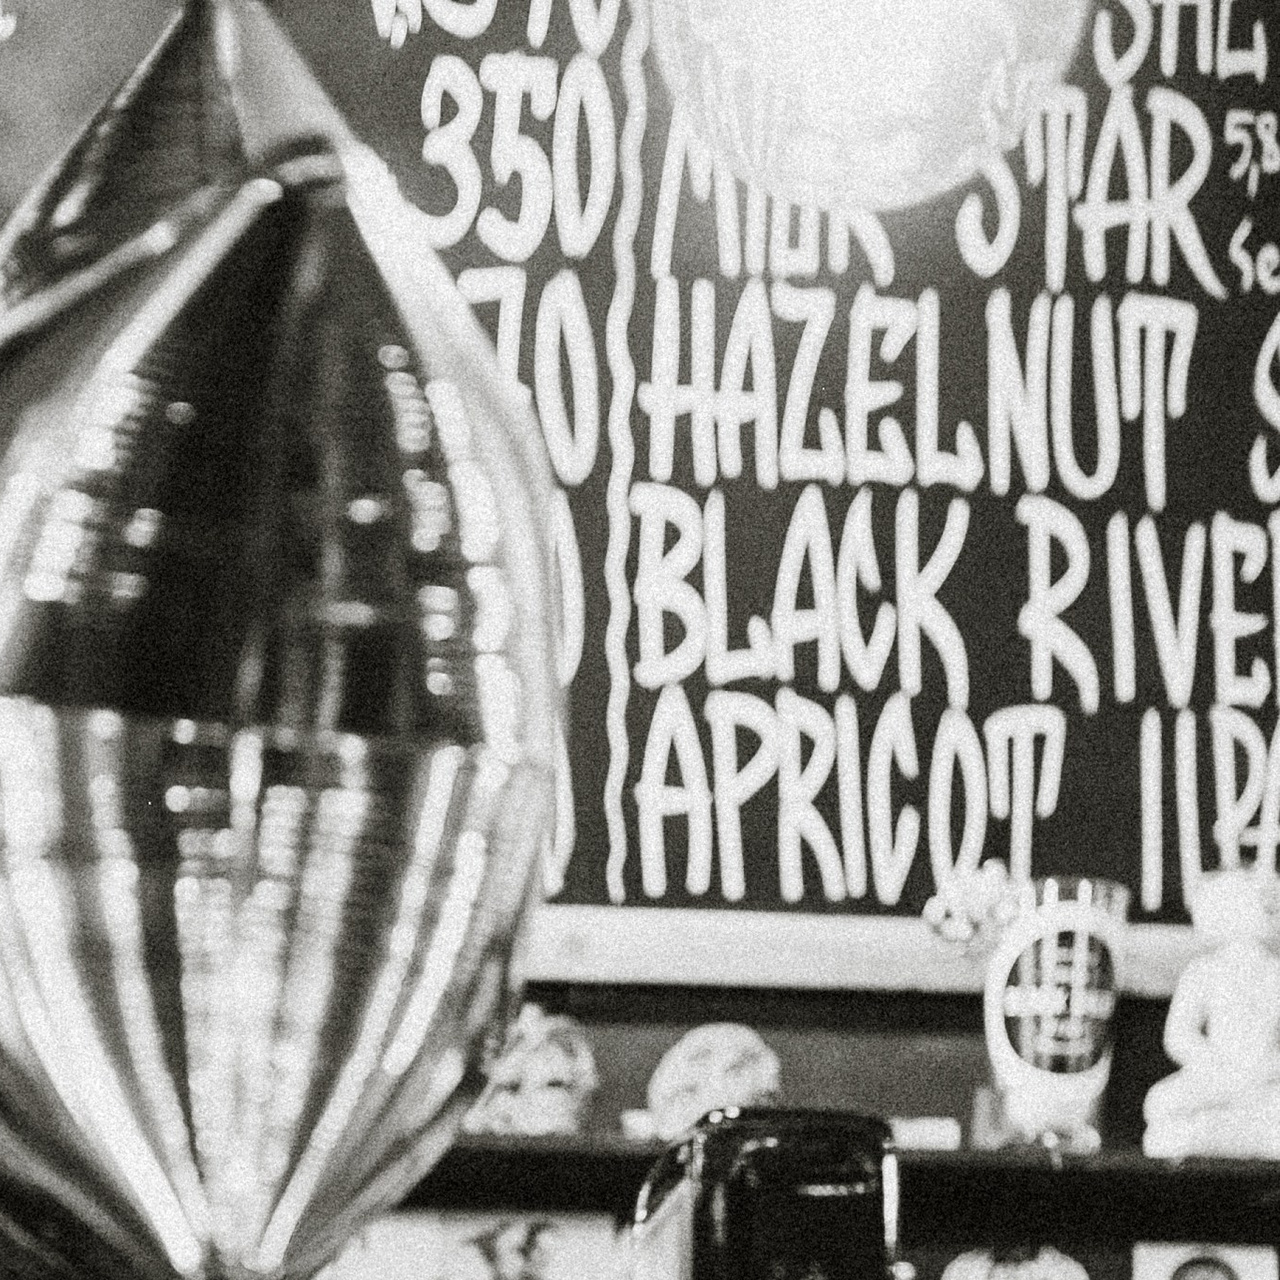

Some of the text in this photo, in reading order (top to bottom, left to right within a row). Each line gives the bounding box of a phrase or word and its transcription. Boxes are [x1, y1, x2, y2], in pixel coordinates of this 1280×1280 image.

[410, 52, 616, 262] 350
[628, 481, 971, 712] BLACK
[634, 684, 1066, 905] APRICOT
